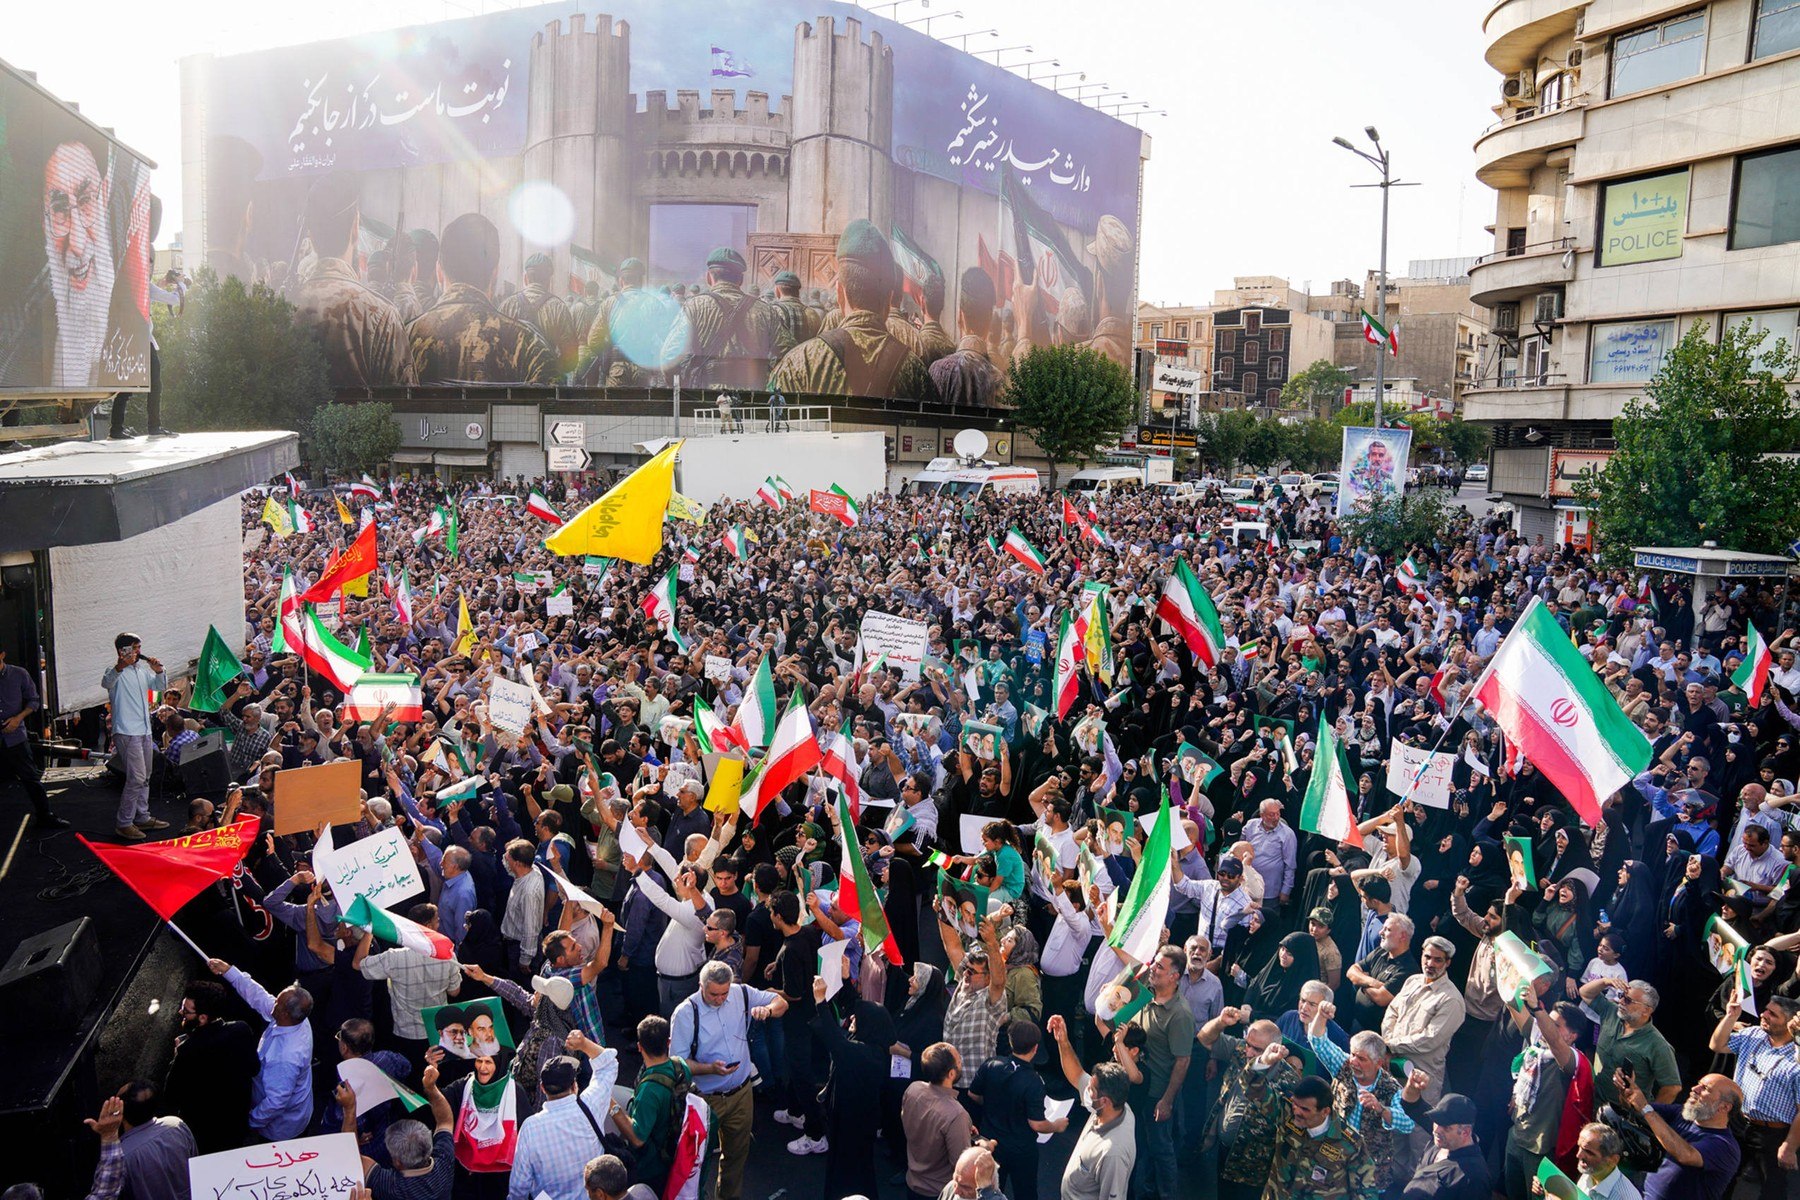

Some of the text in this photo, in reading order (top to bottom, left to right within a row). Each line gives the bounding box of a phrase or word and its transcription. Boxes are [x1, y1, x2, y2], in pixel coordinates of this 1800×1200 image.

[380, 82, 445, 125] ماست
[447, 58, 511, 124] نوبت
[288, 72, 328, 153] بکنیم
[992, 139, 1061, 186] حیدر
[1050, 153, 1091, 192] وارث
[1613, 196, 1678, 226] پلیس
[1609, 229, 1679, 253] POLICE
[1637, 554, 1666, 567] POLICE
[1730, 563, 1757, 574] POLICE
[370, 839, 399, 868] آمریکا
[245, 1145, 319, 1169] هدف
[330, 1175, 357, 1193] همه
